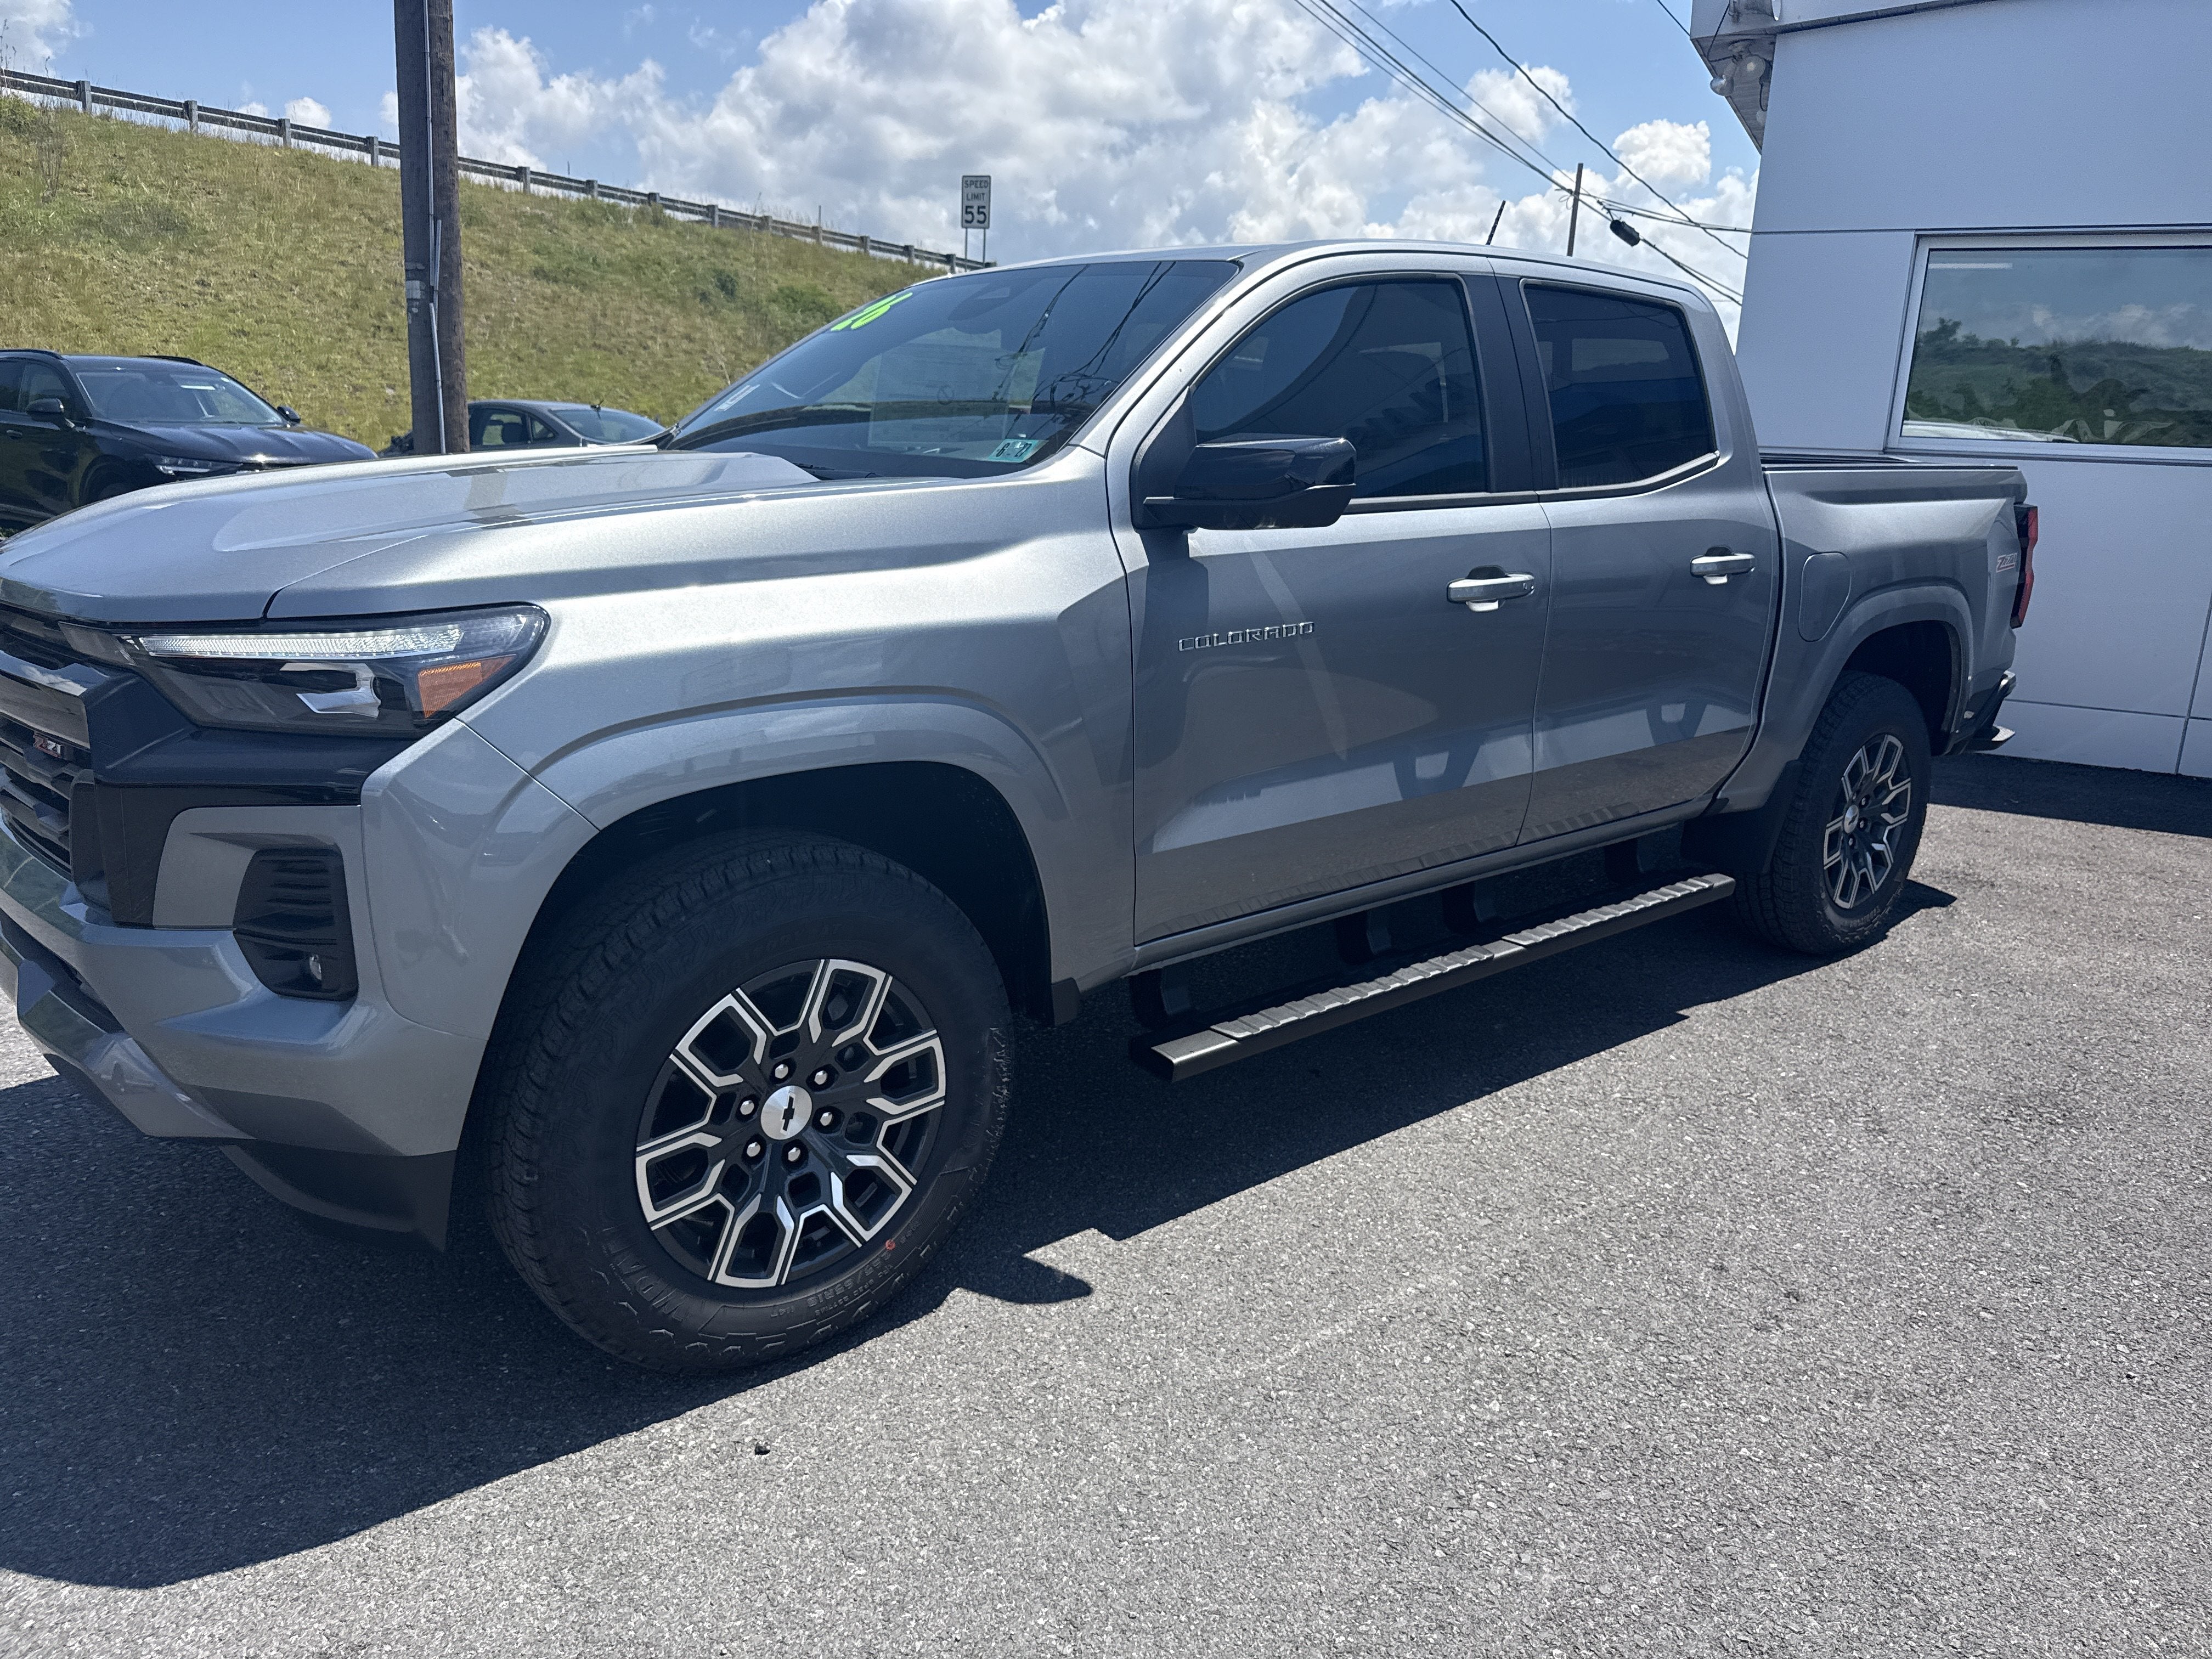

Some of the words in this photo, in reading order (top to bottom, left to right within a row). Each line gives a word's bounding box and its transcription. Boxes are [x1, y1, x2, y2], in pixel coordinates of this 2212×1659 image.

[964, 179, 989, 189] SPEED
[966, 193, 986, 201] LIMIT
[964, 205, 987, 224] 55
[1178, 622, 1315, 651] COLORADO
